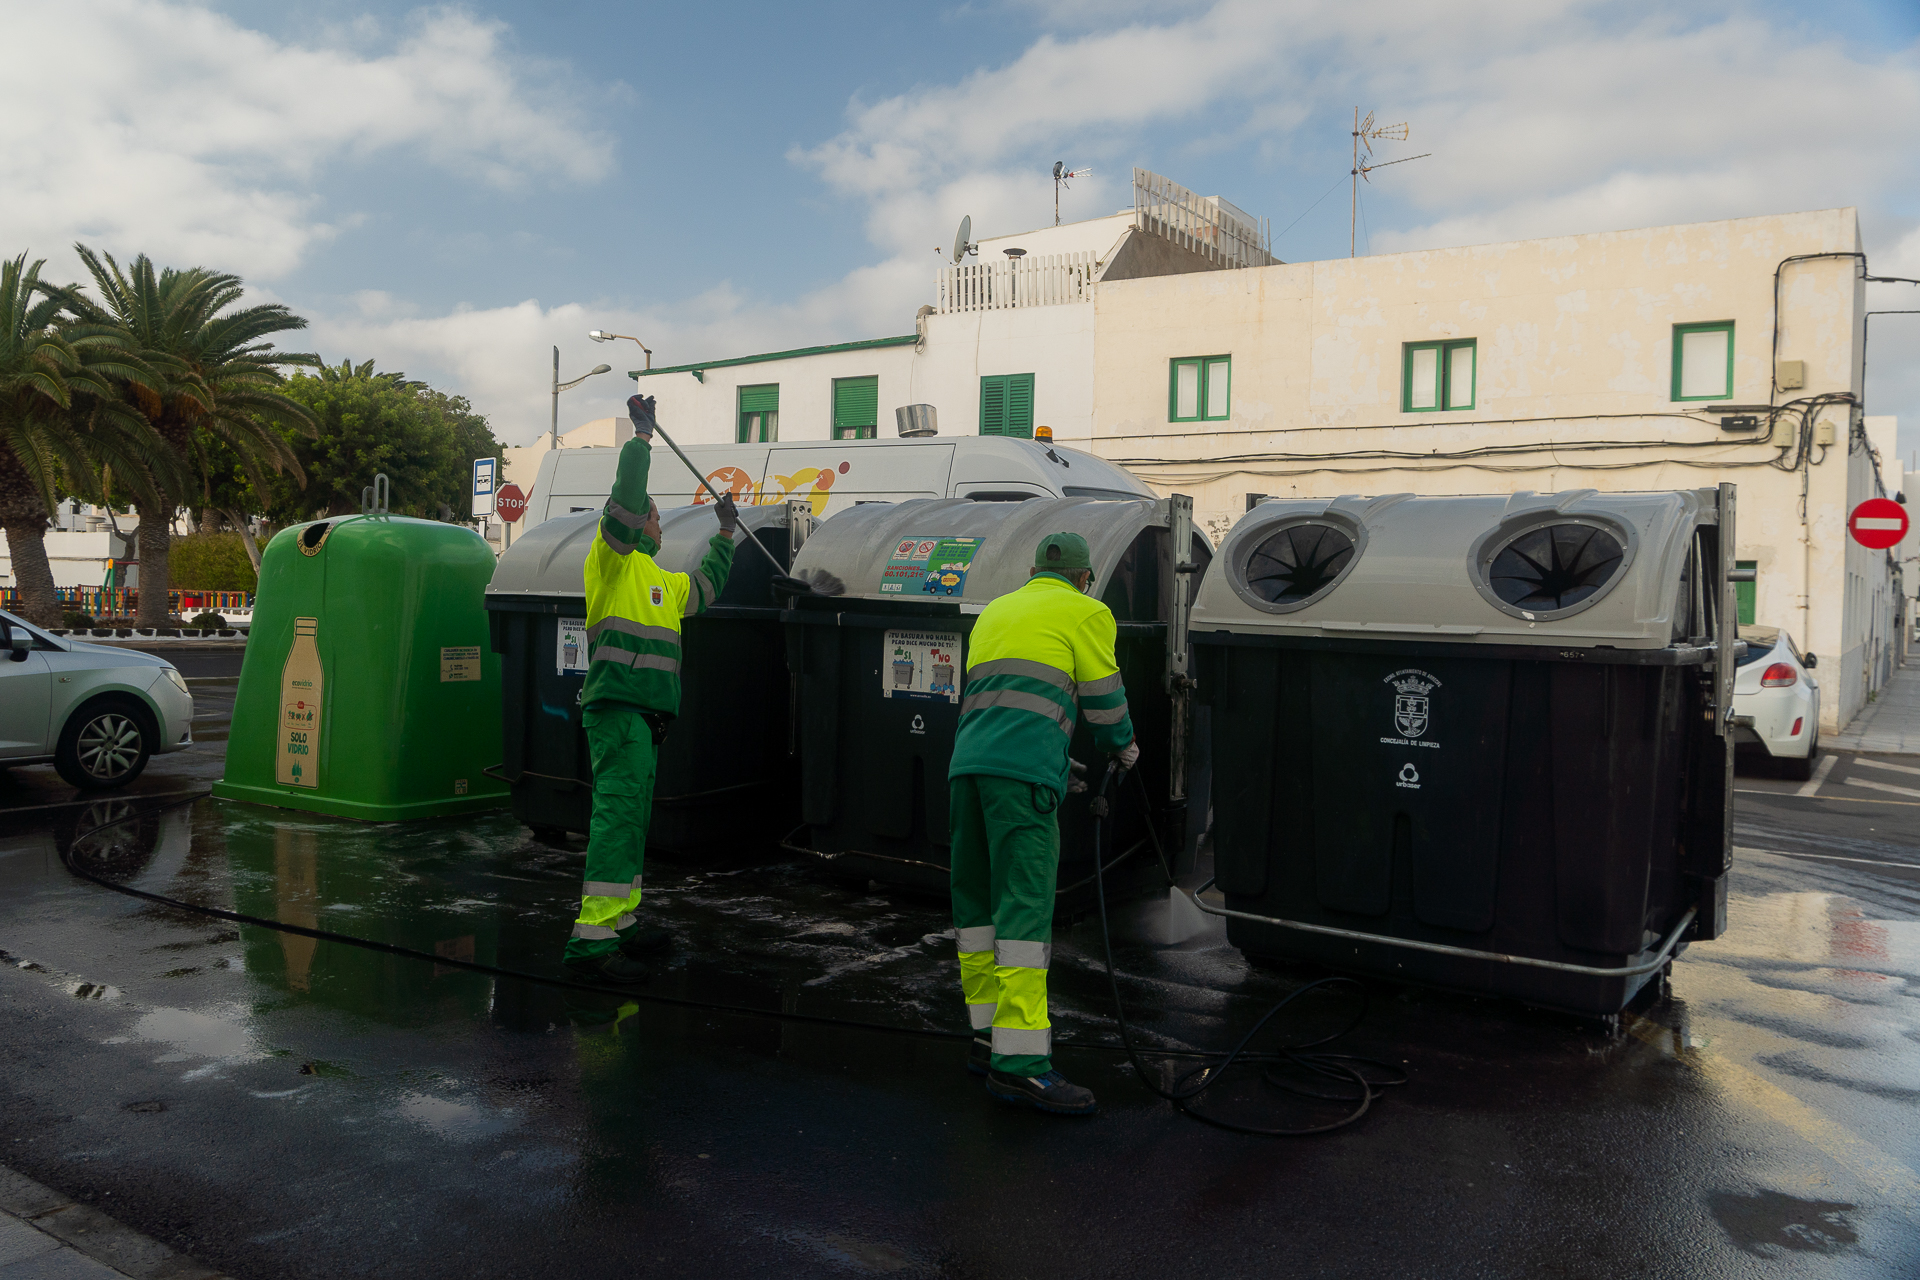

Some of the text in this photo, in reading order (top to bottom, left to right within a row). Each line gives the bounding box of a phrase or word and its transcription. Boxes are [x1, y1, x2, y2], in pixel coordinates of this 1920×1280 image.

[498, 498, 524, 508] STOP
[304, 542, 322, 555] VIDRIO
[939, 654, 950, 663] NO
[291, 732, 307, 743] SOLO
[288, 743, 309, 755] VIDRIO
